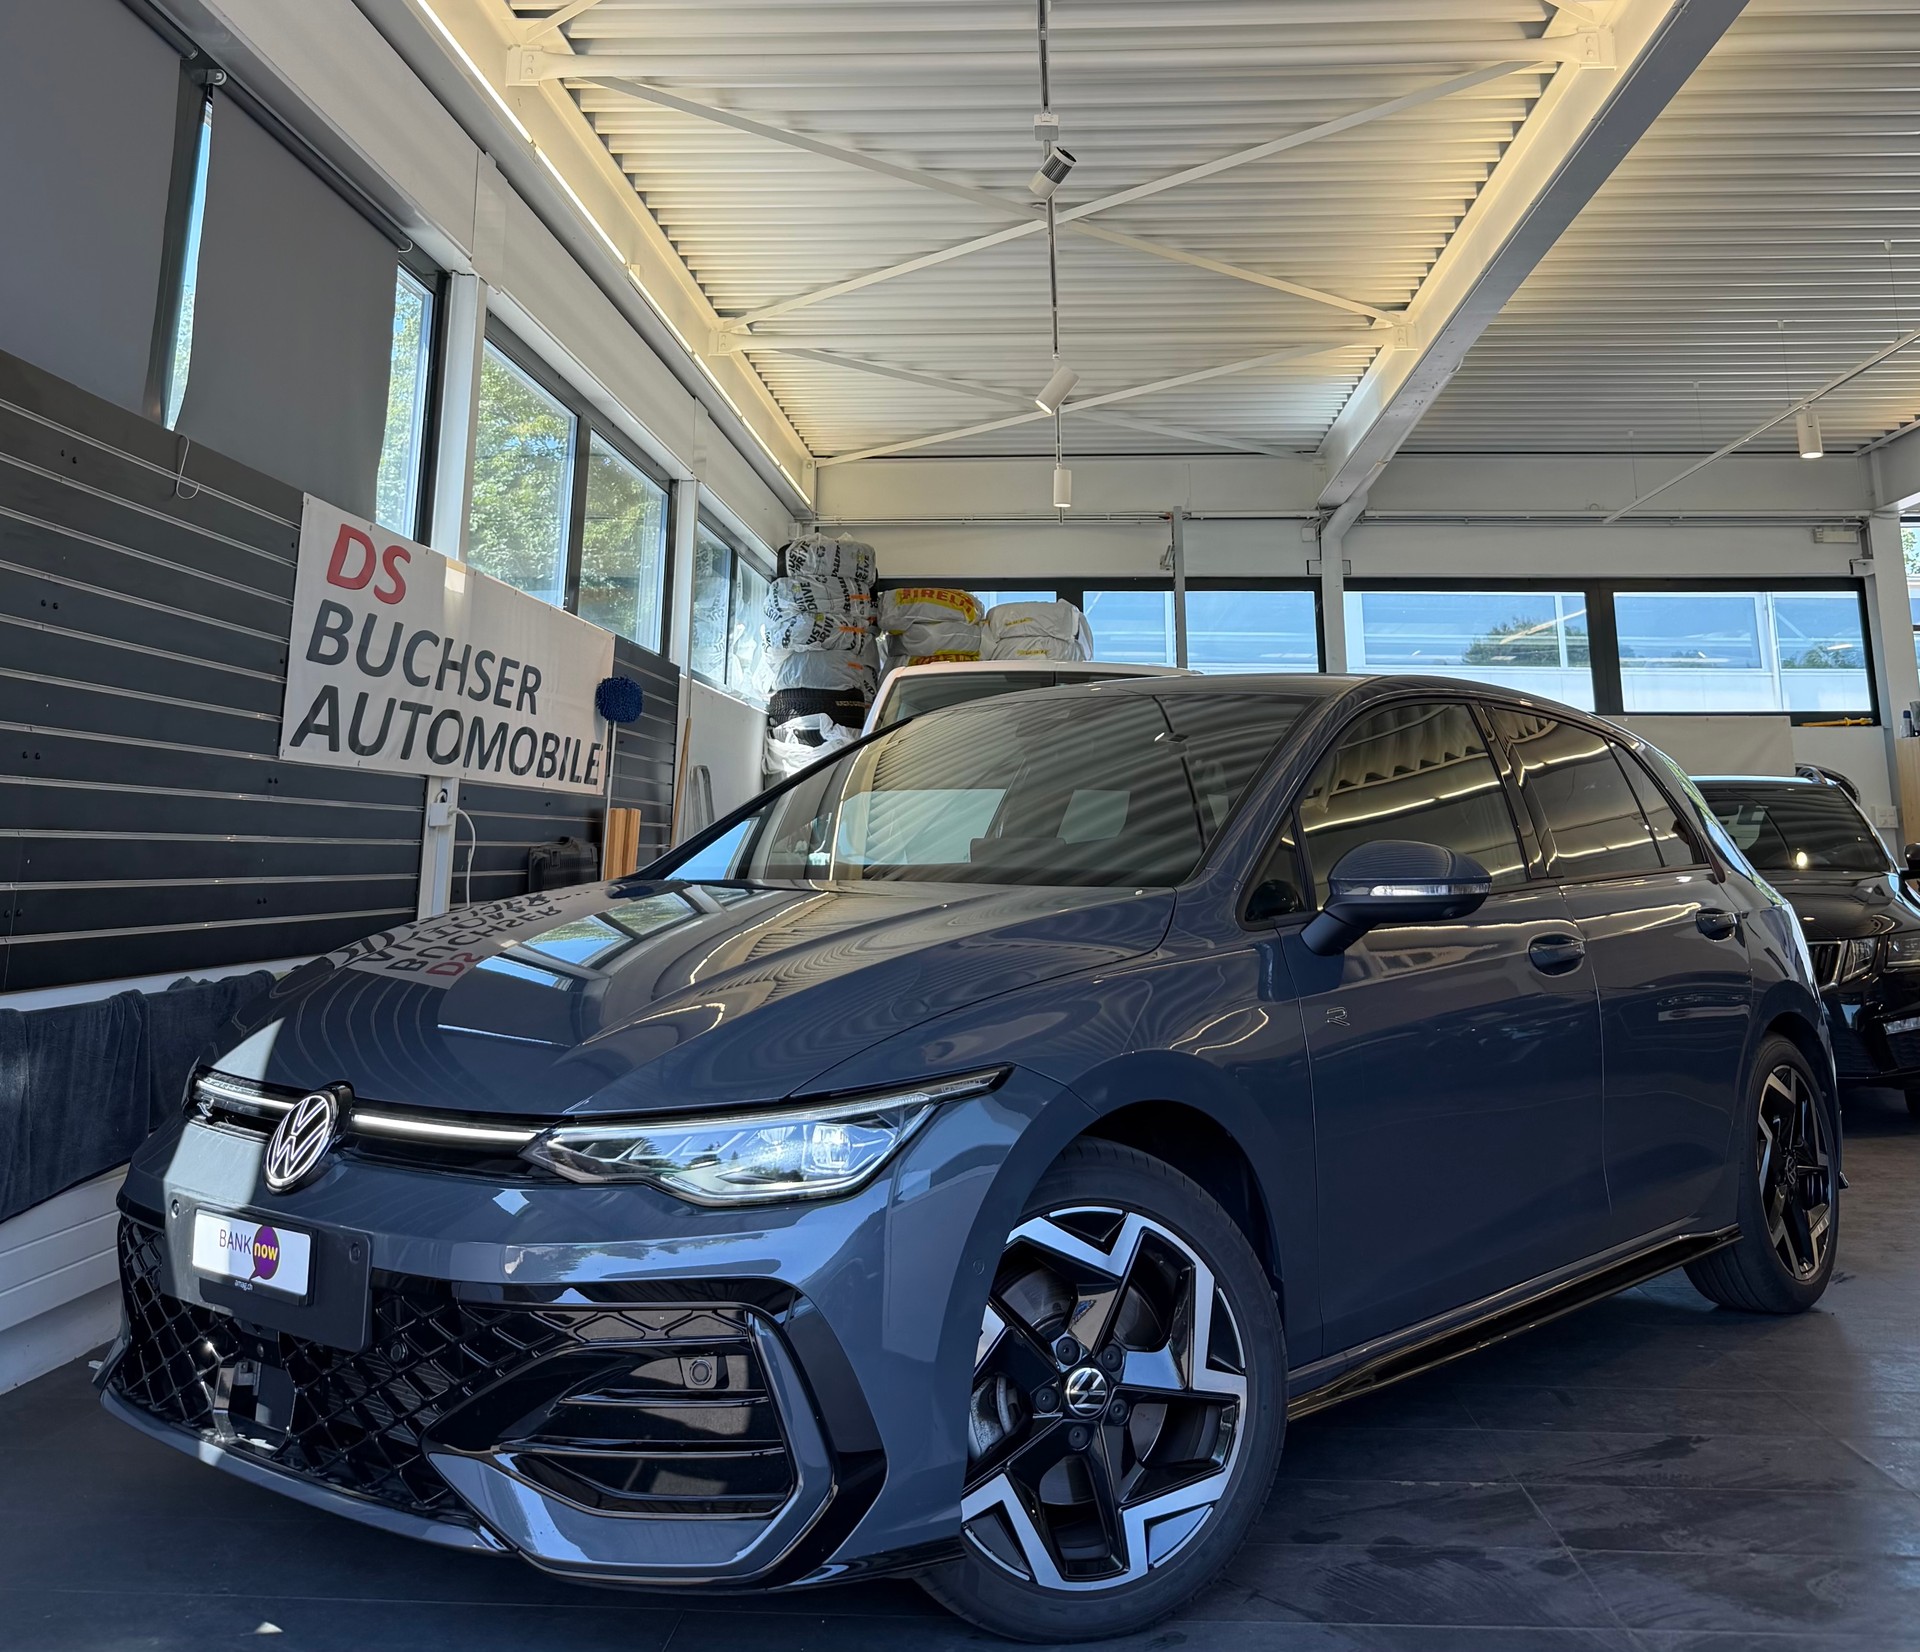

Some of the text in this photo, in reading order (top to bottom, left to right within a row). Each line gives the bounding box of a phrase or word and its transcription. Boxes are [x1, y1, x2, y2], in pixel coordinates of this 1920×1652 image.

[326, 523, 411, 605] DS
[306, 599, 542, 715] BUCHSER
[289, 685, 604, 786] AUTOMOBILE
[219, 1229, 279, 1261] BANK now
